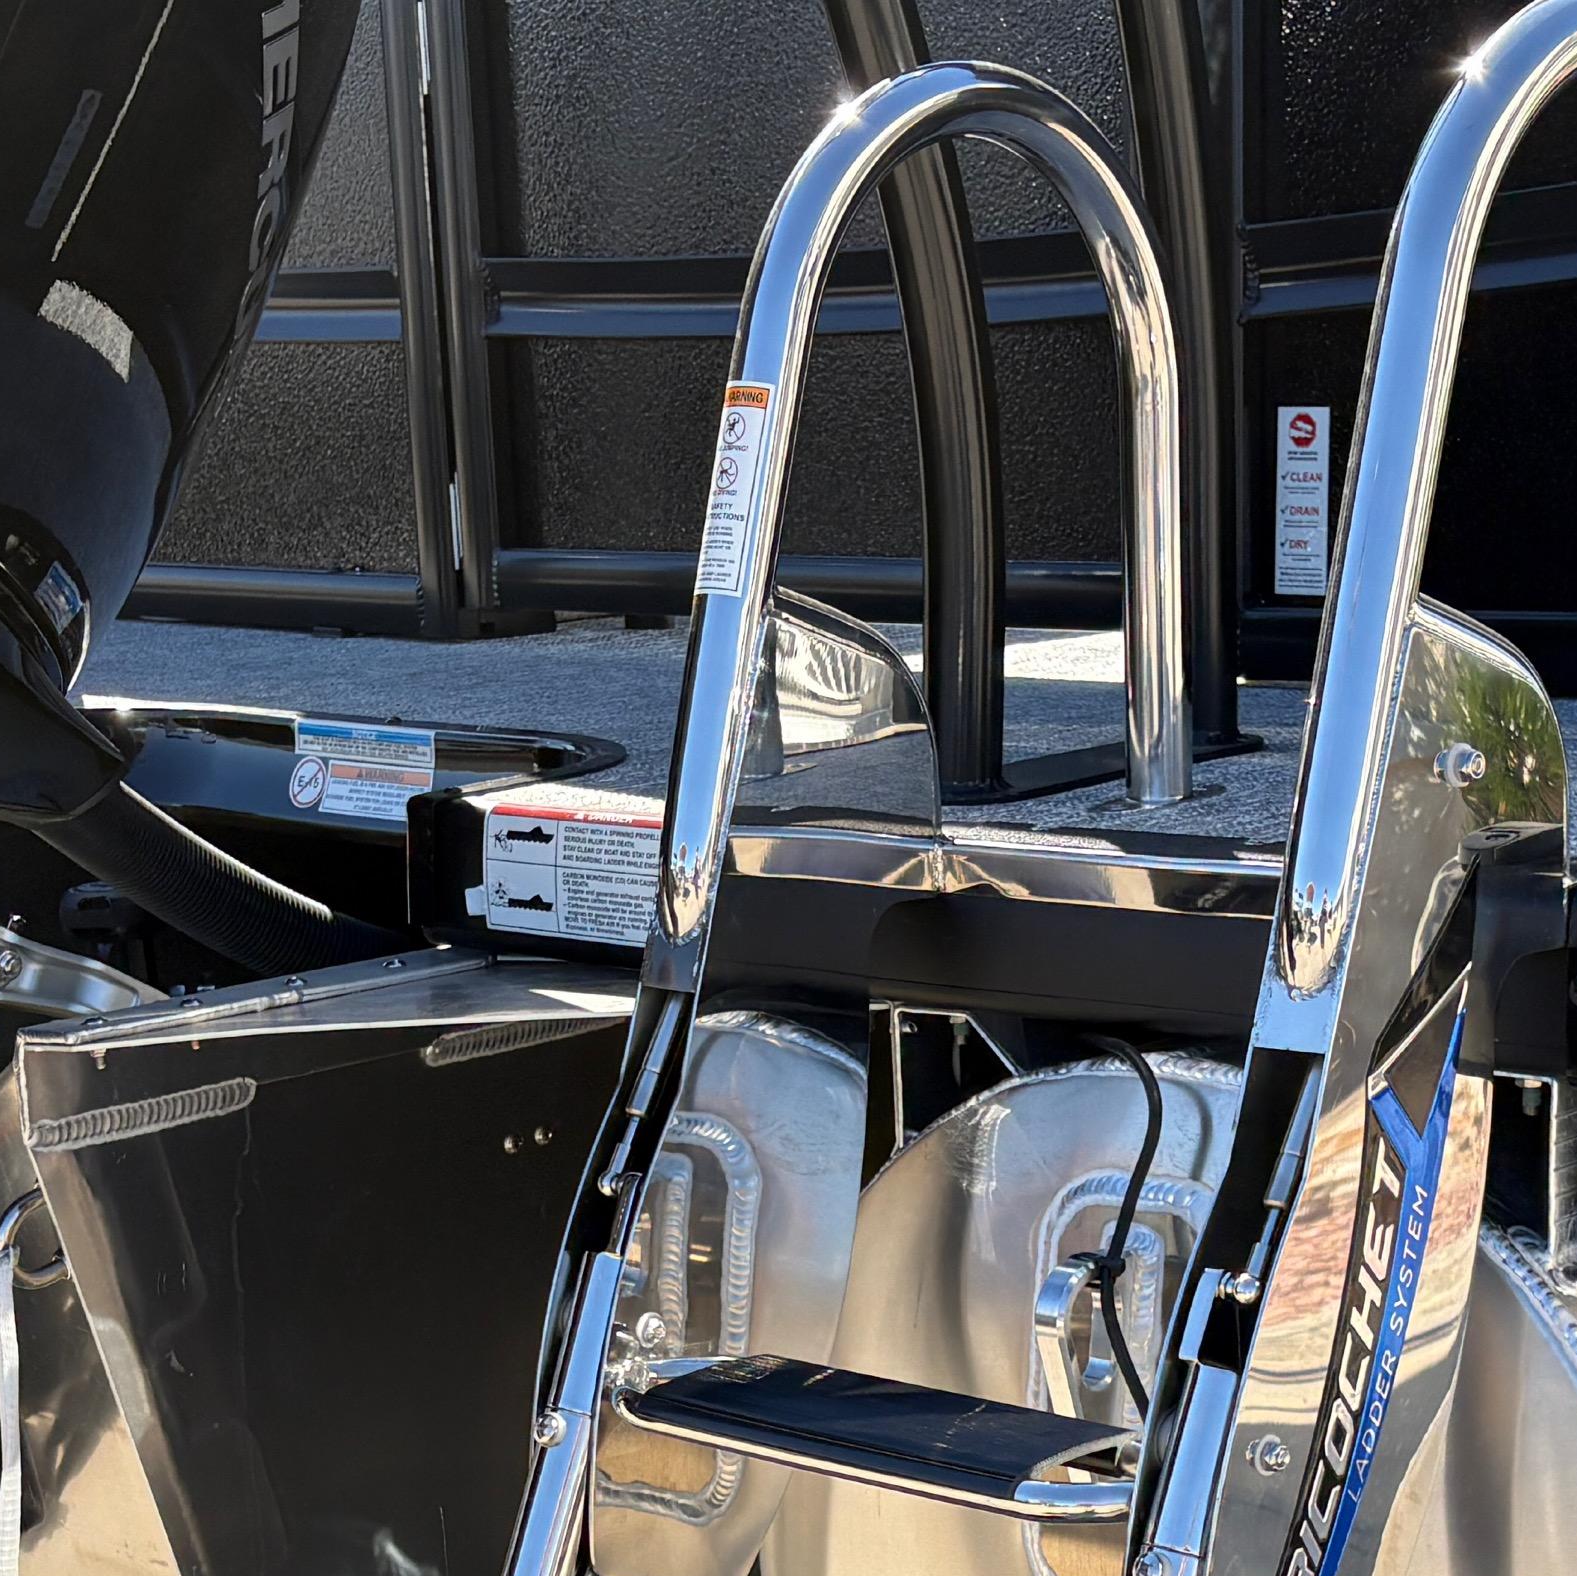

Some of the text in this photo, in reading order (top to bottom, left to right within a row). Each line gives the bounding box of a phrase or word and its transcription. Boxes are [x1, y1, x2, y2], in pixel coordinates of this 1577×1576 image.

[728, 390, 764, 404] ARNING
[1289, 472, 1323, 483] CLEAN
[1289, 506, 1320, 516] DRAIN
[1288, 540, 1310, 550] DRY
[577, 846, 595, 854] CLEAR
[1347, 1184, 1428, 1502] LADDER SYSTEM
